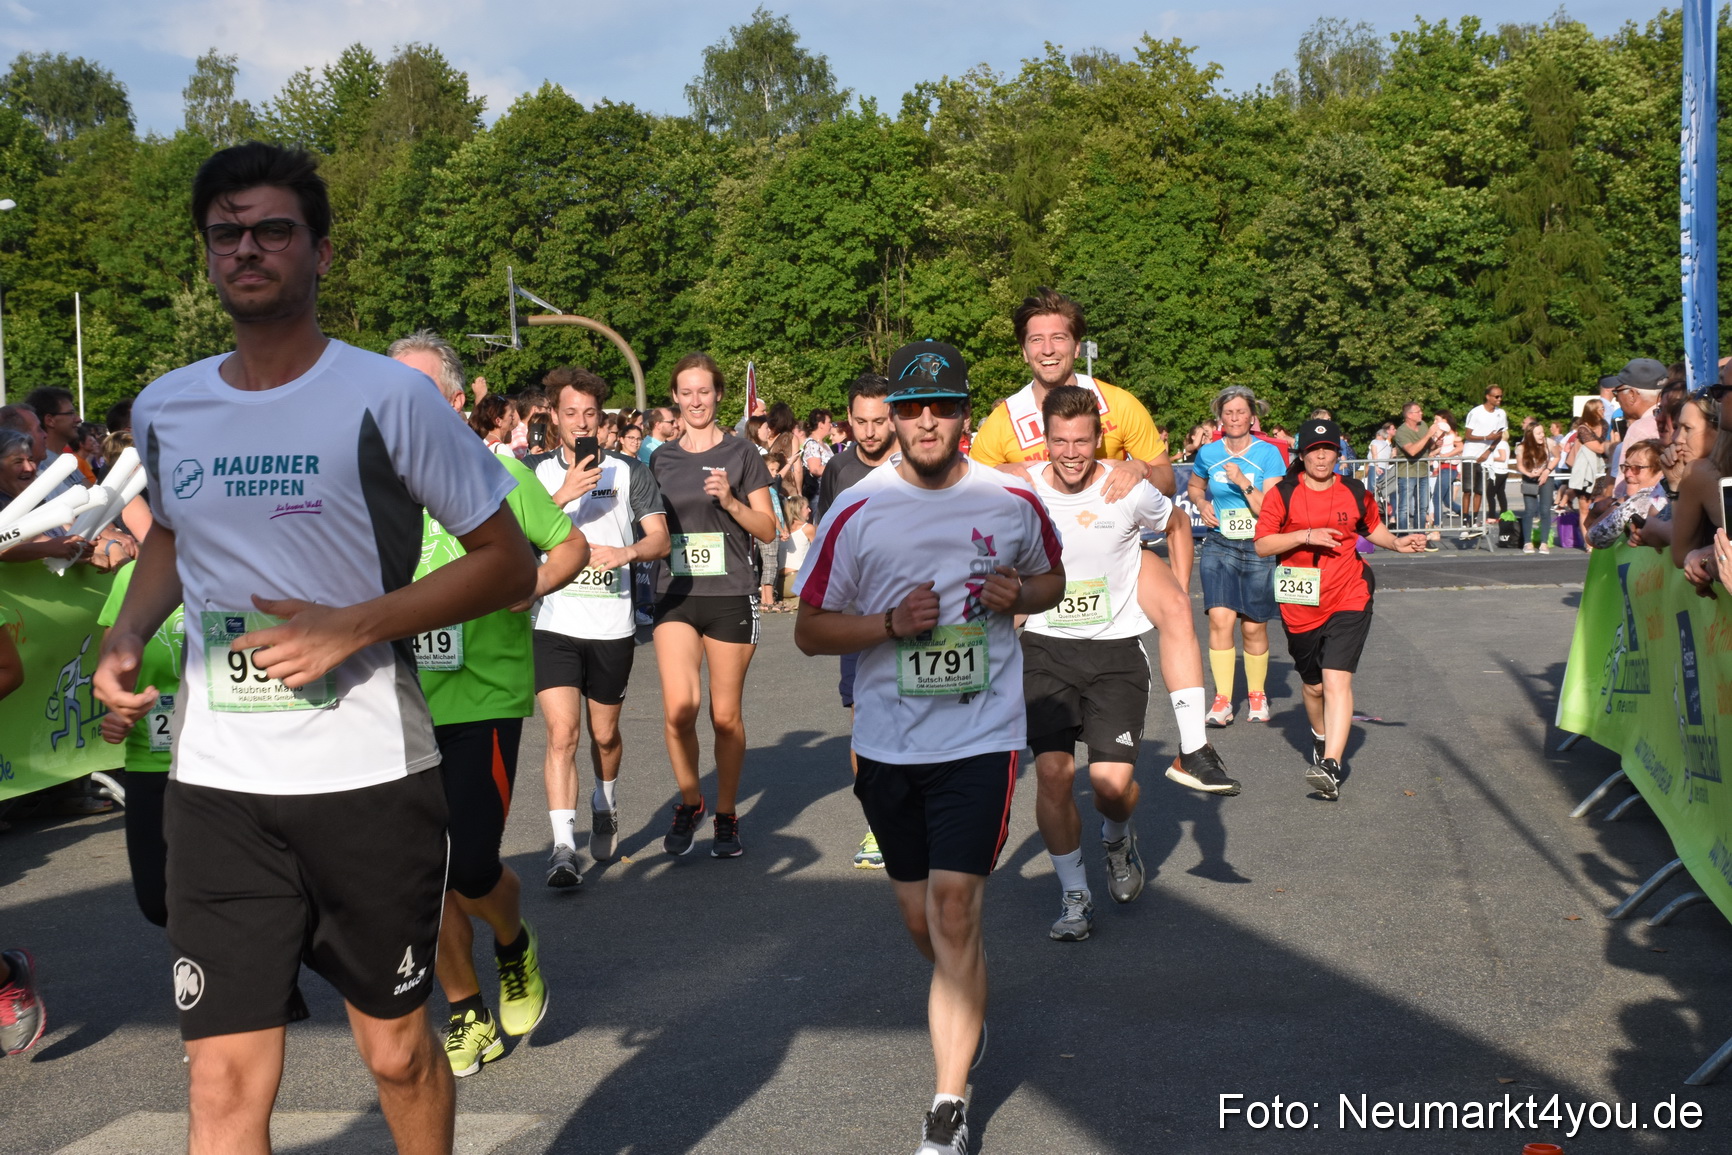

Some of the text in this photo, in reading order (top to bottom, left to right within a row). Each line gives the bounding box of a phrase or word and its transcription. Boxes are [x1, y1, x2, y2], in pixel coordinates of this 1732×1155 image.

[212, 454, 320, 476] HAUBNER
[224, 479, 304, 497] TREPPEN
[1229, 519, 1253, 531] 828
[1337, 512, 1348, 522] 13
[681, 548, 711, 564] 159
[568, 570, 614, 586] 280
[1280, 579, 1313, 594] 2343
[908, 647, 975, 676] 1791
[944, 673, 972, 683] Michael
[231, 685, 272, 694] Haubner
[155, 714, 170, 735] 2
[396, 944, 416, 979] 4
